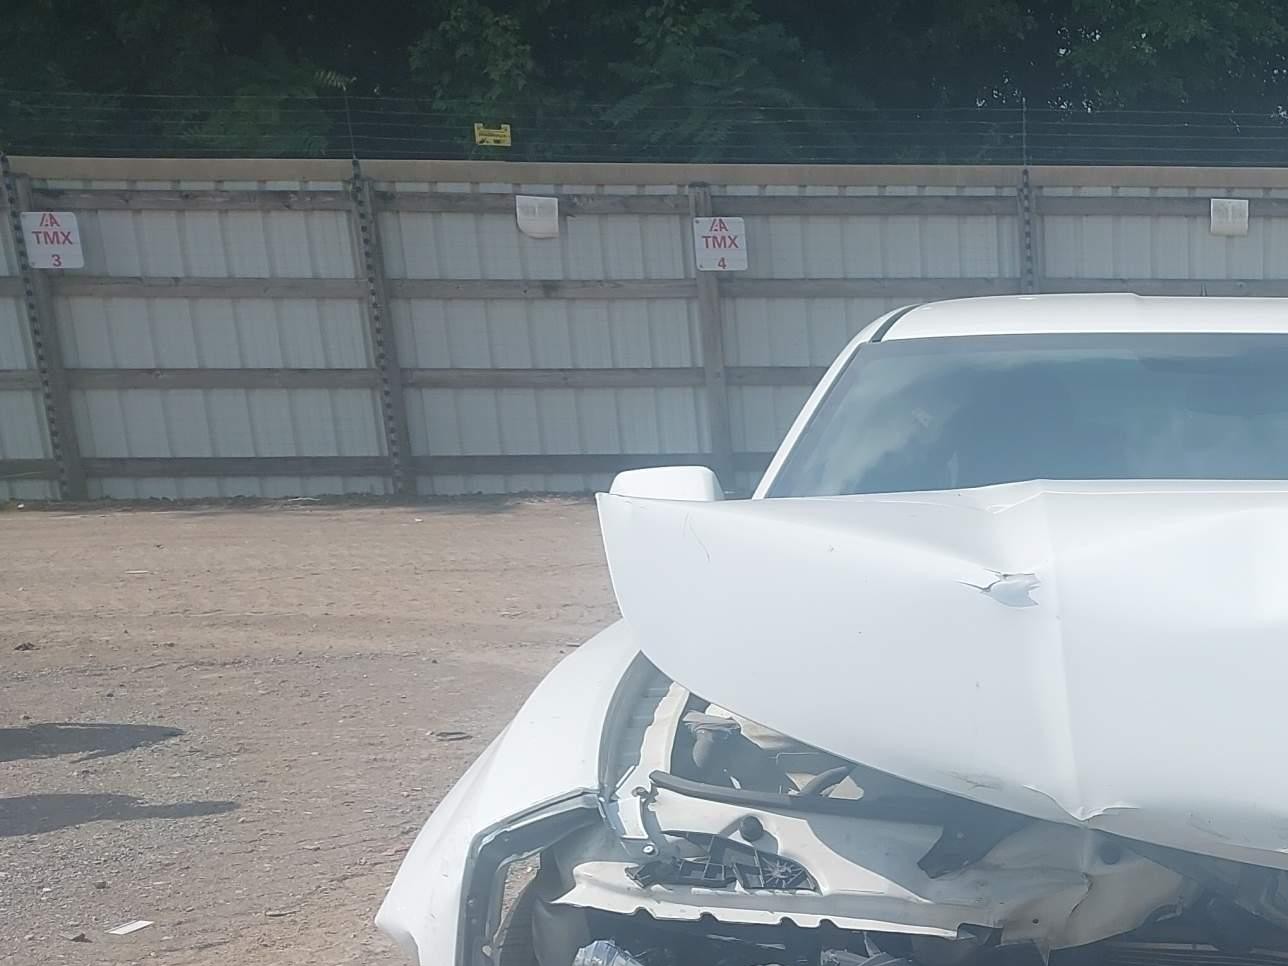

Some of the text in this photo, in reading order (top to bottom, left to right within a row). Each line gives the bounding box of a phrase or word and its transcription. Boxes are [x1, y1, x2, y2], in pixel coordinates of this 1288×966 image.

[31, 230, 73, 245] TMX
[701, 235, 740, 249] TMX
[51, 253, 62, 268] 3
[717, 256, 727, 270] 4
